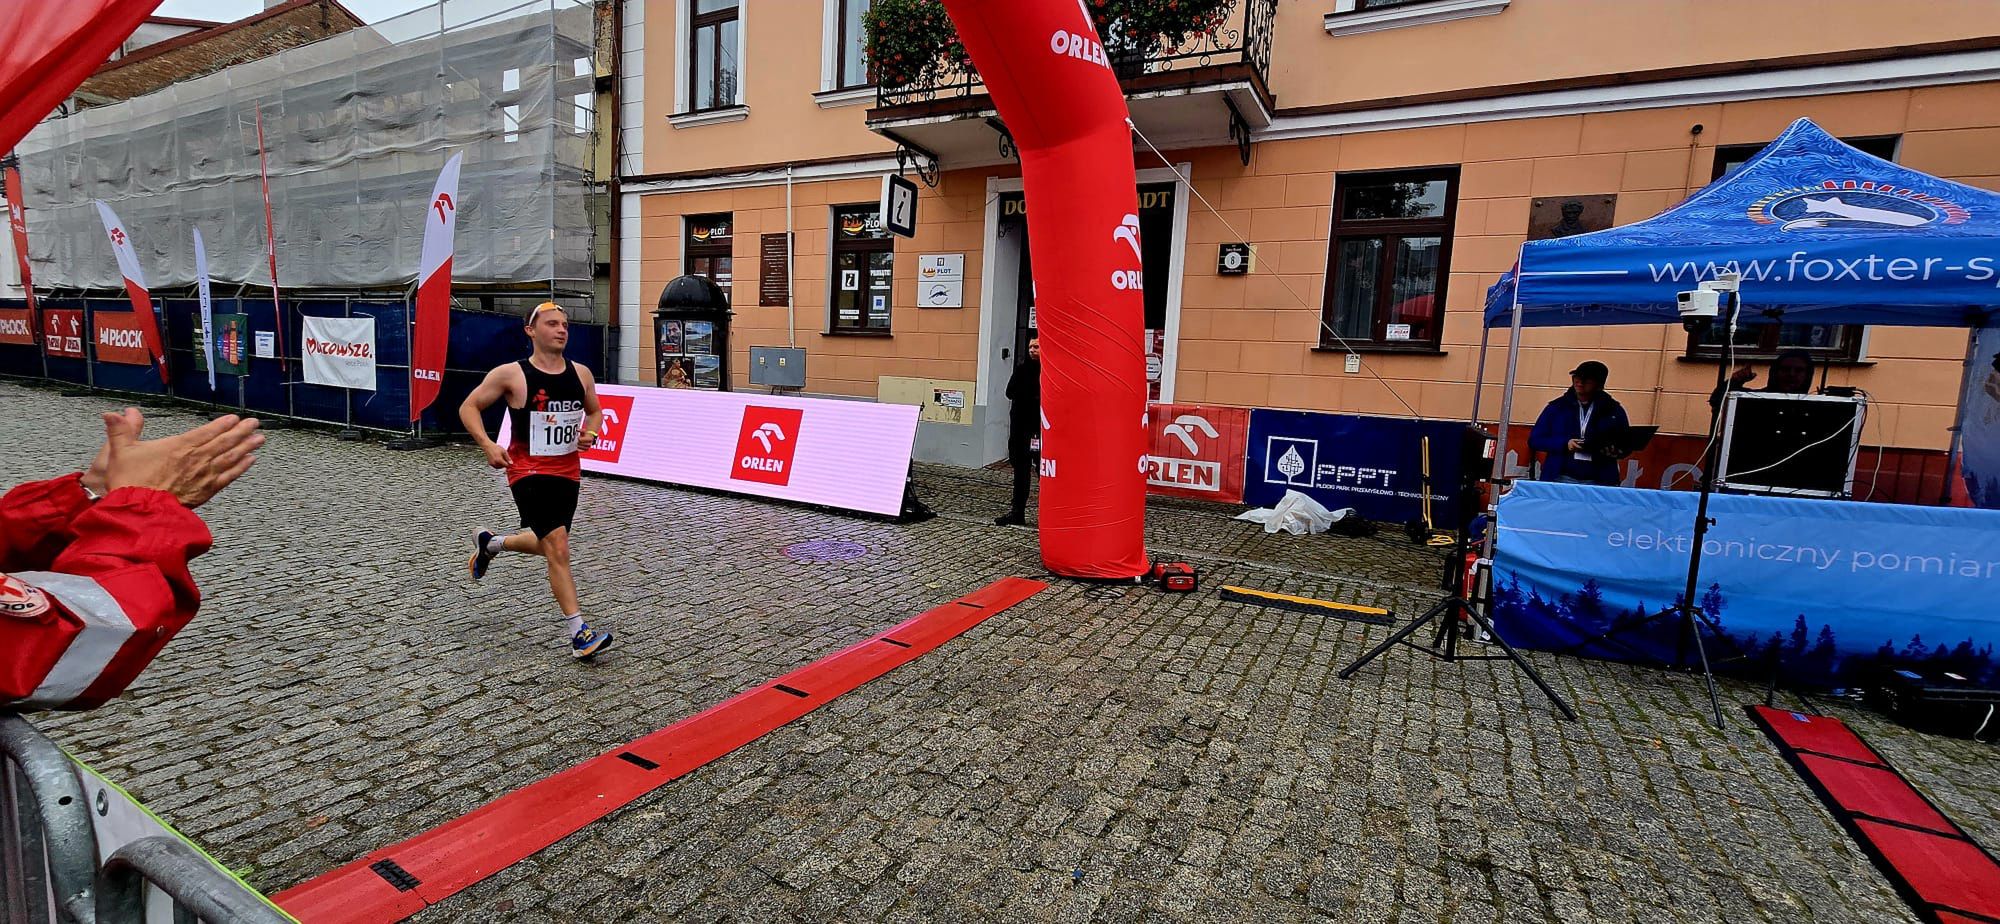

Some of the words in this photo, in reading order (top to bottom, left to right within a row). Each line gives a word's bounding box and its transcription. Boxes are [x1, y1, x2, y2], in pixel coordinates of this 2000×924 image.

[710, 227, 726, 237] PLOT
[865, 219, 881, 229] PLO
[1648, 251, 2000, 289] www.foxter-s
[109, 326, 144, 349] PŁOCK
[741, 456, 784, 473] ORLEN
[1316, 463, 1397, 488] PPPT
[1607, 528, 1841, 569] elektoniczny
